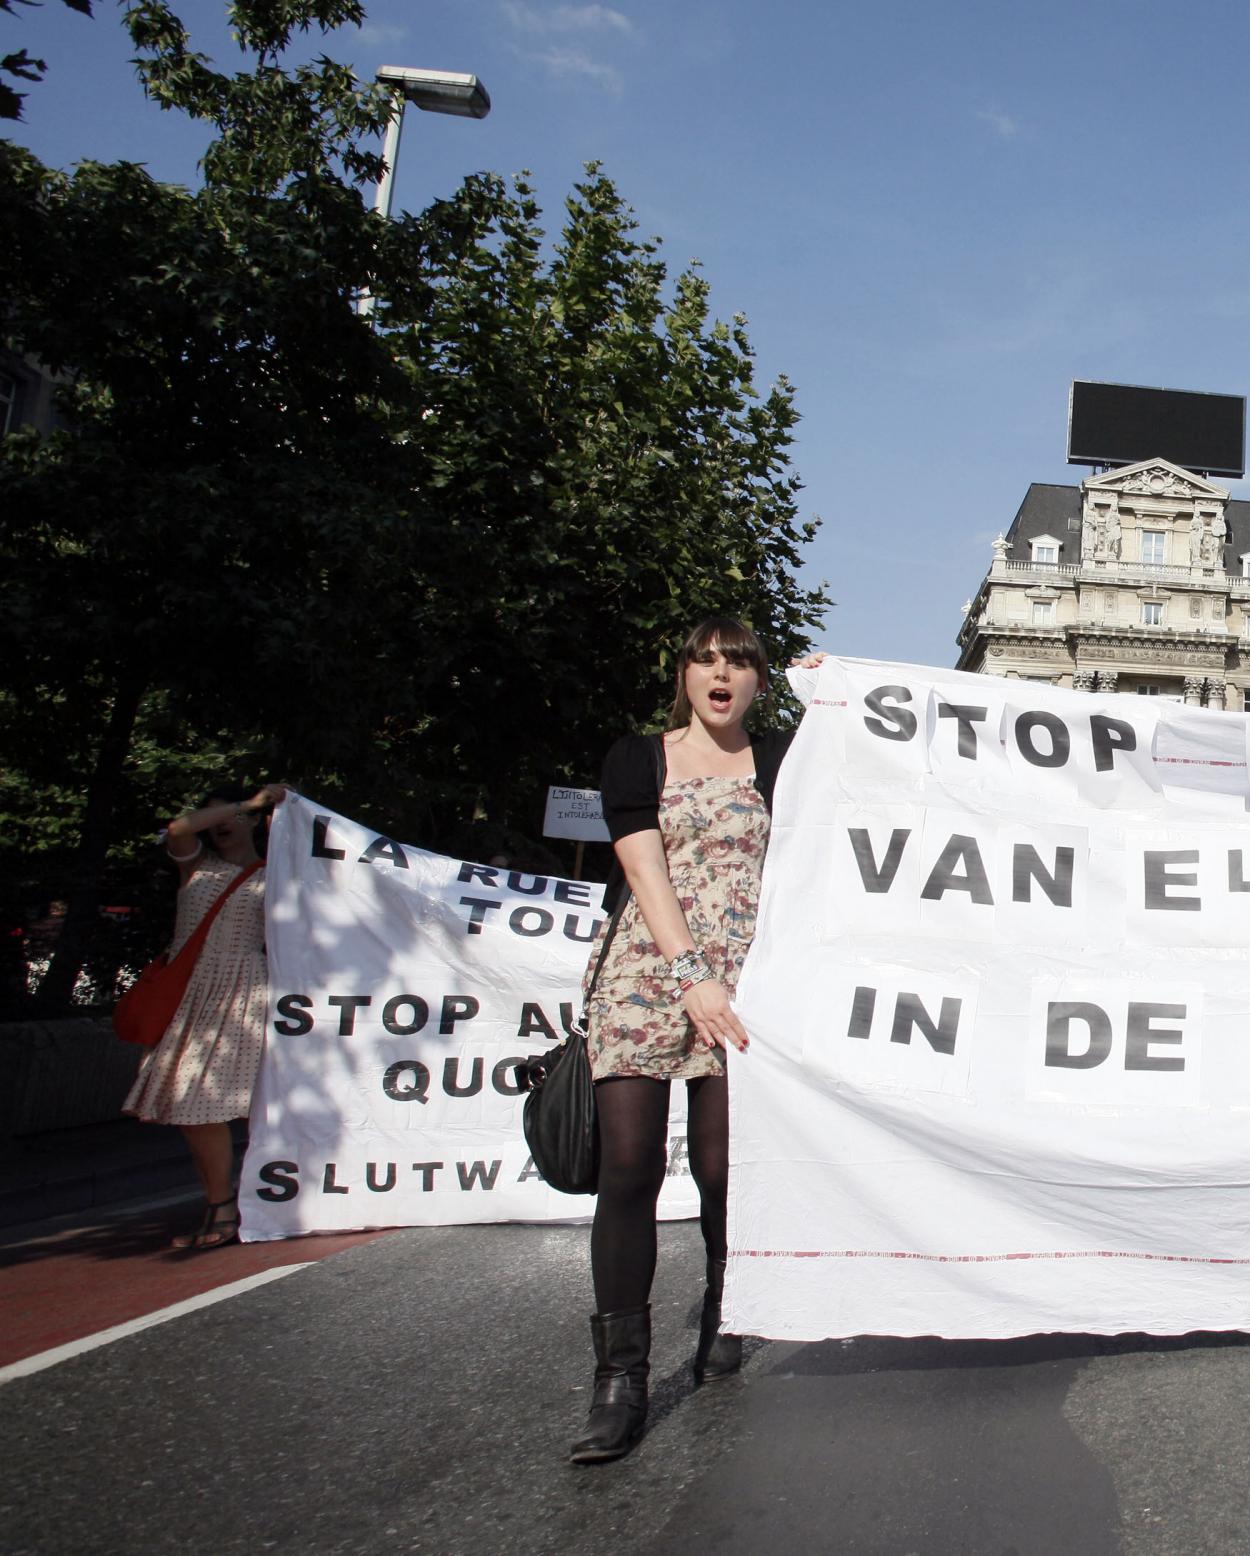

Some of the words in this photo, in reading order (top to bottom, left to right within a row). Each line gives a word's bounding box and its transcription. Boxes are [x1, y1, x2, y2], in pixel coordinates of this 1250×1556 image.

[863, 685, 1137, 772] STOP
[571, 802, 590, 811] EST
[311, 814, 409, 869] LA
[457, 861, 591, 907] RUE
[848, 828, 1075, 908] VAN
[459, 896, 602, 943] TOU
[274, 994, 479, 1037] STOP
[847, 986, 962, 1056] IN
[1044, 1001, 1187, 1072] DE
